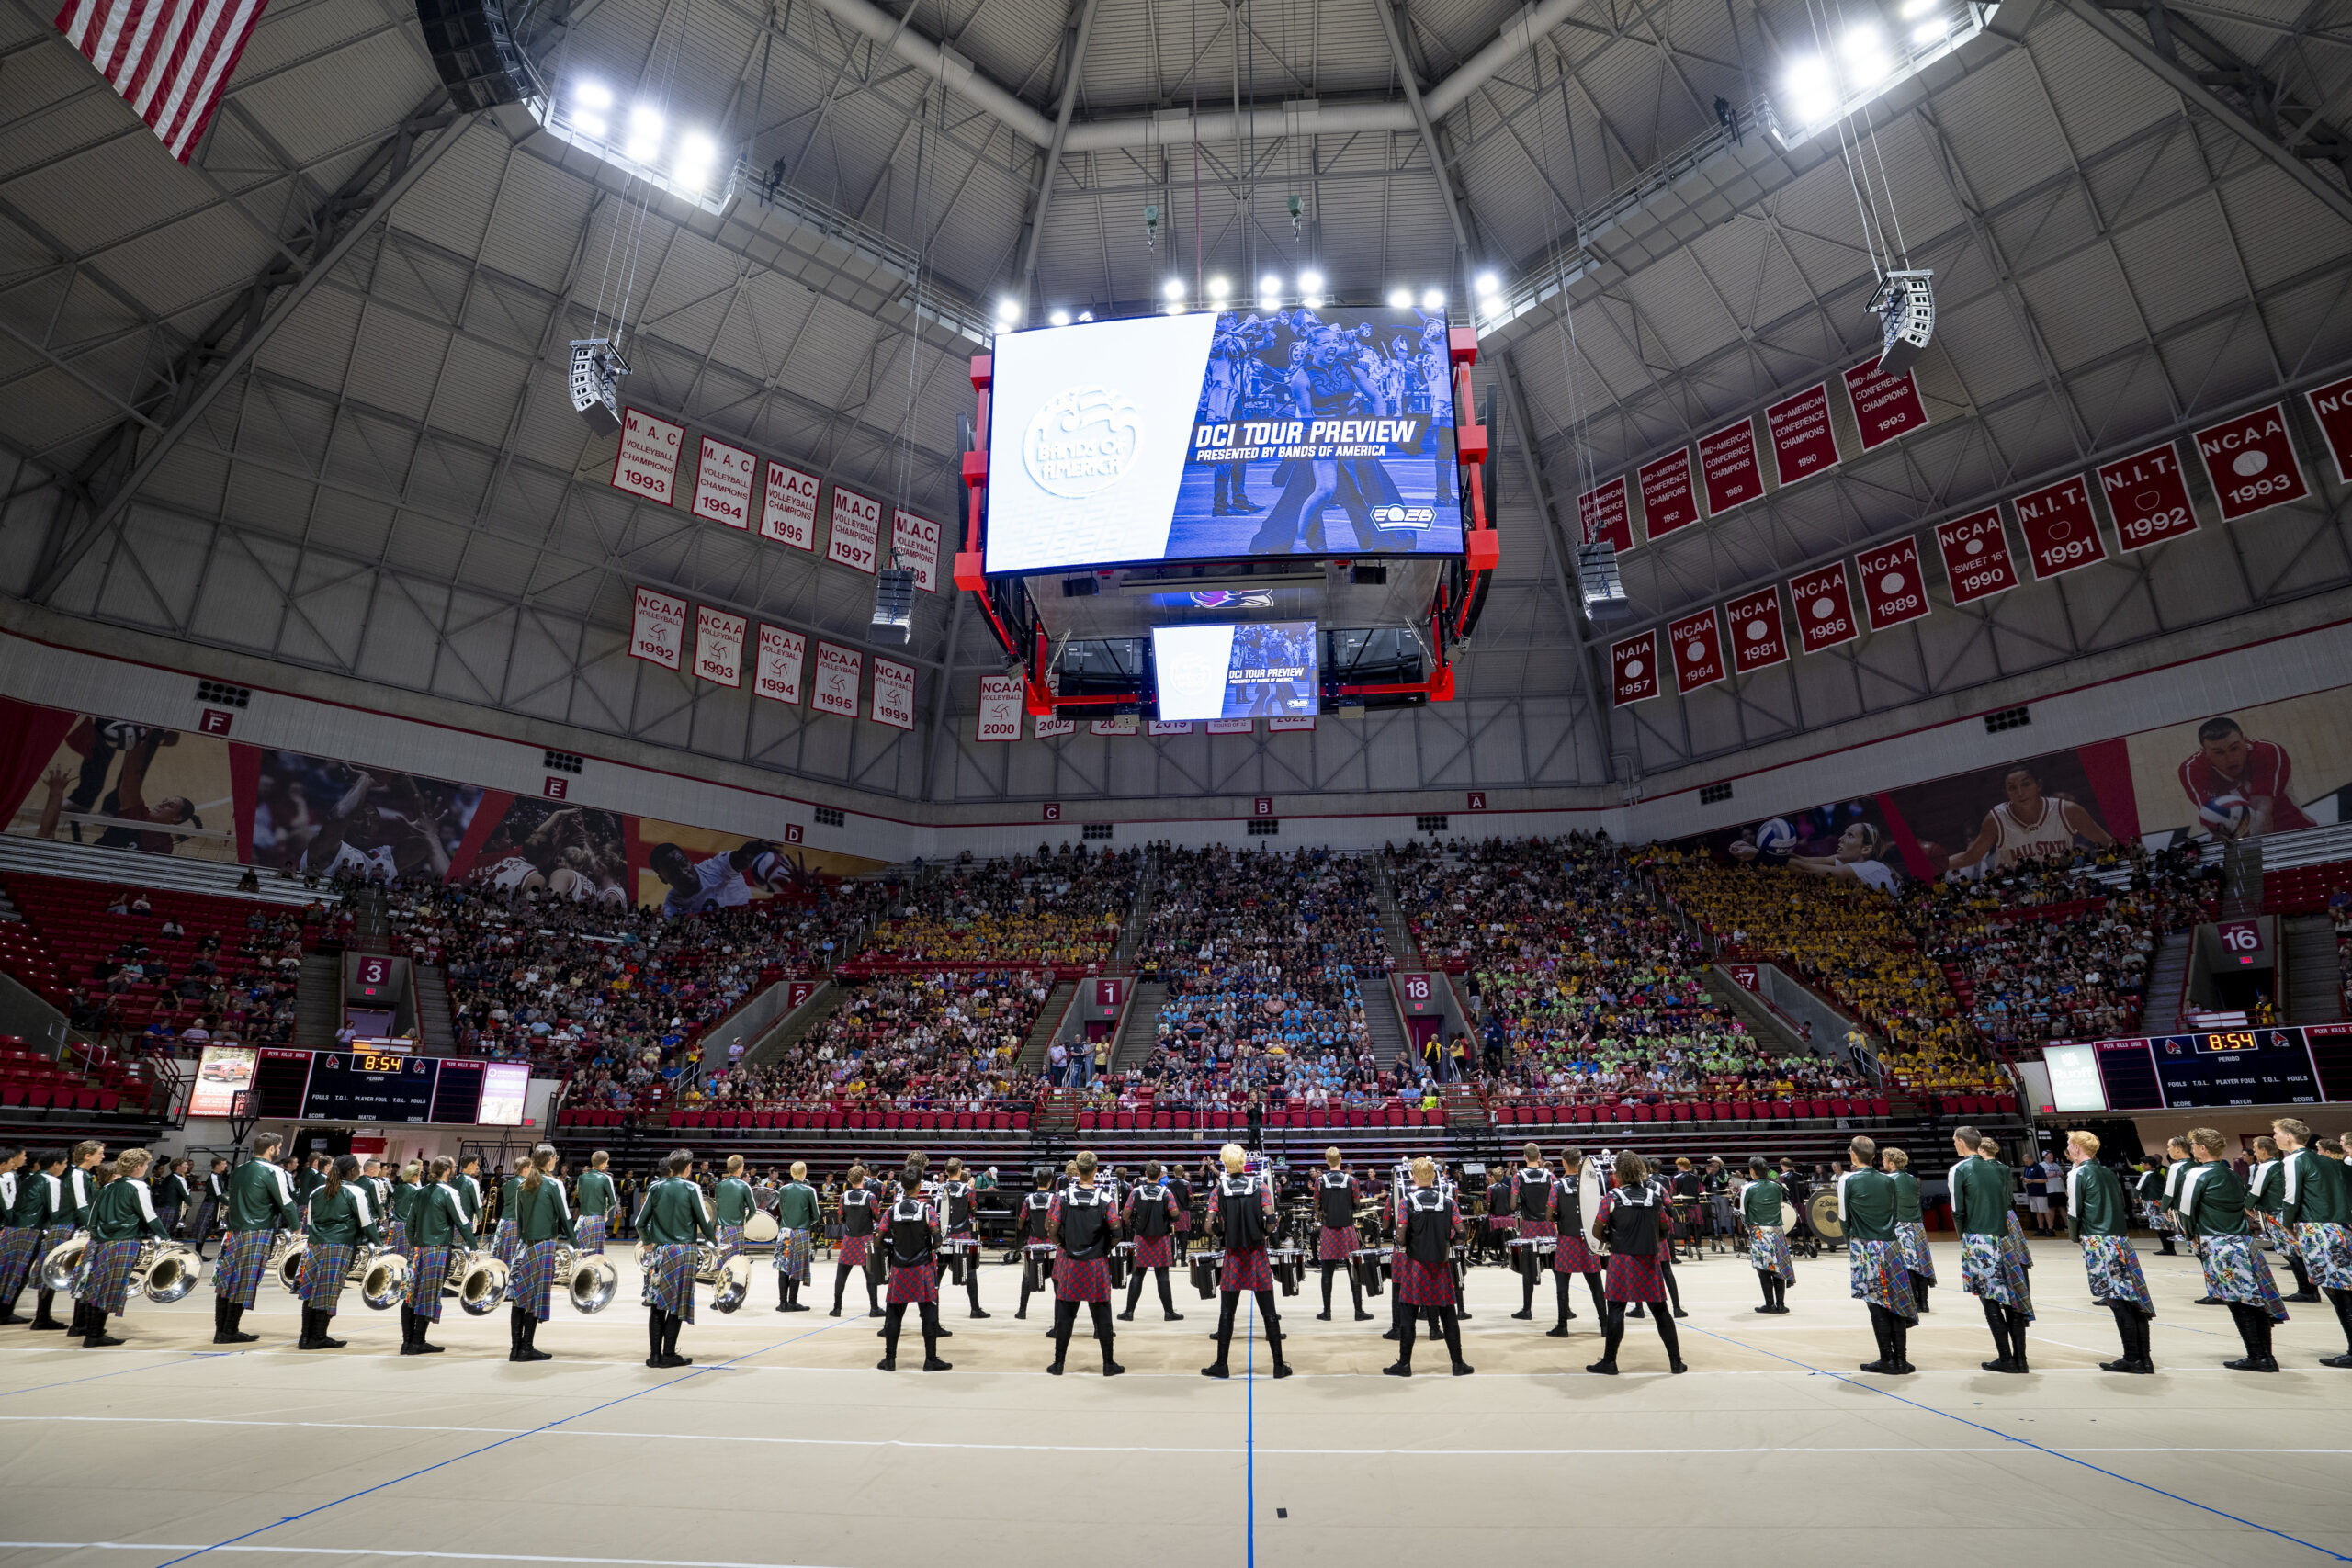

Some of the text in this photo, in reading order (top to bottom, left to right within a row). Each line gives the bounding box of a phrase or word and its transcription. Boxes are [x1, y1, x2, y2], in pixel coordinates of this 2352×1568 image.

[1862, 386, 1908, 412] CHAMPIONS
[1770, 395, 1825, 425] MID-AMERICAN
[1775, 411, 1825, 437] CONFERENCE
[1877, 412, 1905, 431] 1993
[1195, 420, 1416, 447] DCI TOUR PREVIEW
[1702, 429, 1751, 457] MID-AMERICAN
[1781, 424, 1825, 450] CHAMPIONS
[2201, 419, 2283, 457] NCAA
[626, 439, 673, 461] VOLLEYBALL
[1196, 445, 1385, 461] PRESENTED BY BANDS OF AMERICA
[1705, 444, 1750, 468] CONFERENCE
[1797, 453, 1817, 468] 1990
[622, 451, 673, 474] CHAMPIONS
[1642, 458, 1688, 484] MID-AMERICAN
[1711, 458, 1750, 480] CHAMPIONS
[624, 469, 665, 493] 1993
[704, 467, 749, 489] VOLLEYBALL
[1645, 471, 1688, 495] CONFERENCE
[700, 479, 748, 500] CHAMPIONS
[1649, 485, 1687, 506] CHAMPIONS
[1725, 485, 1743, 498] 1989
[2228, 473, 2292, 505] 1993
[702, 496, 741, 519] 1994
[768, 489, 814, 512] VOLLEYBALL
[768, 500, 811, 521] CHAMPIONS
[834, 513, 876, 535] VOLLEYBALL
[1662, 511, 1679, 524] 1982
[2123, 506, 2188, 540] 1992
[774, 520, 803, 542] 1996
[835, 524, 874, 545] CHAMPIONS
[1940, 517, 2000, 547] NCAA
[834, 542, 872, 564] 1997
[1860, 548, 1916, 576] NCAA
[2041, 536, 2095, 567] 1991
[1793, 573, 1844, 600] NCAA
[1961, 568, 2004, 592] 1990
[638, 594, 684, 619] NCAA
[1729, 597, 1777, 623] NCAA
[1878, 593, 1918, 617] 1989
[639, 607, 681, 626] VOLLEYBALL
[699, 614, 743, 635] NCAA
[701, 626, 741, 644] VOLLEYBALL
[1673, 618, 1713, 641] NCAA
[1809, 617, 1848, 641] 1986
[639, 640, 674, 660] 1992
[761, 631, 803, 653] NCAA
[763, 644, 800, 661] VOLLEYBALL
[1616, 641, 1651, 661] NAIA
[1743, 641, 1778, 661] 1981
[819, 648, 859, 669] NCAA
[819, 660, 858, 676] VOLLEYBALL
[701, 660, 734, 679] 1993
[875, 664, 912, 684] NCAA
[1228, 667, 1304, 679] DCI TOUR PREVIEW
[1685, 664, 1714, 682] 1964
[761, 677, 795, 696] 1994
[876, 677, 912, 692] VOLLEYBALL
[982, 682, 1022, 694] NCAA
[1619, 679, 1650, 696] 1957
[820, 693, 853, 710] 1995
[207, 716, 224, 731] F
[879, 706, 909, 722] 1999
[983, 724, 1015, 734] 2000
[1039, 720, 1070, 731] 2002
[549, 783, 561, 796] E
[1259, 802, 1269, 814] B
[1472, 796, 1482, 807] A
[1046, 807, 1057, 819] C
[788, 829, 799, 841] D
[2222, 930, 2258, 951] 16
[366, 964, 382, 983] 3
[794, 989, 807, 1006] 2
[1105, 987, 1114, 1003] 1
[1406, 981, 1429, 998] 18
[2209, 1032, 2255, 1051] 8:54
[364, 1055, 401, 1071] 8:54
